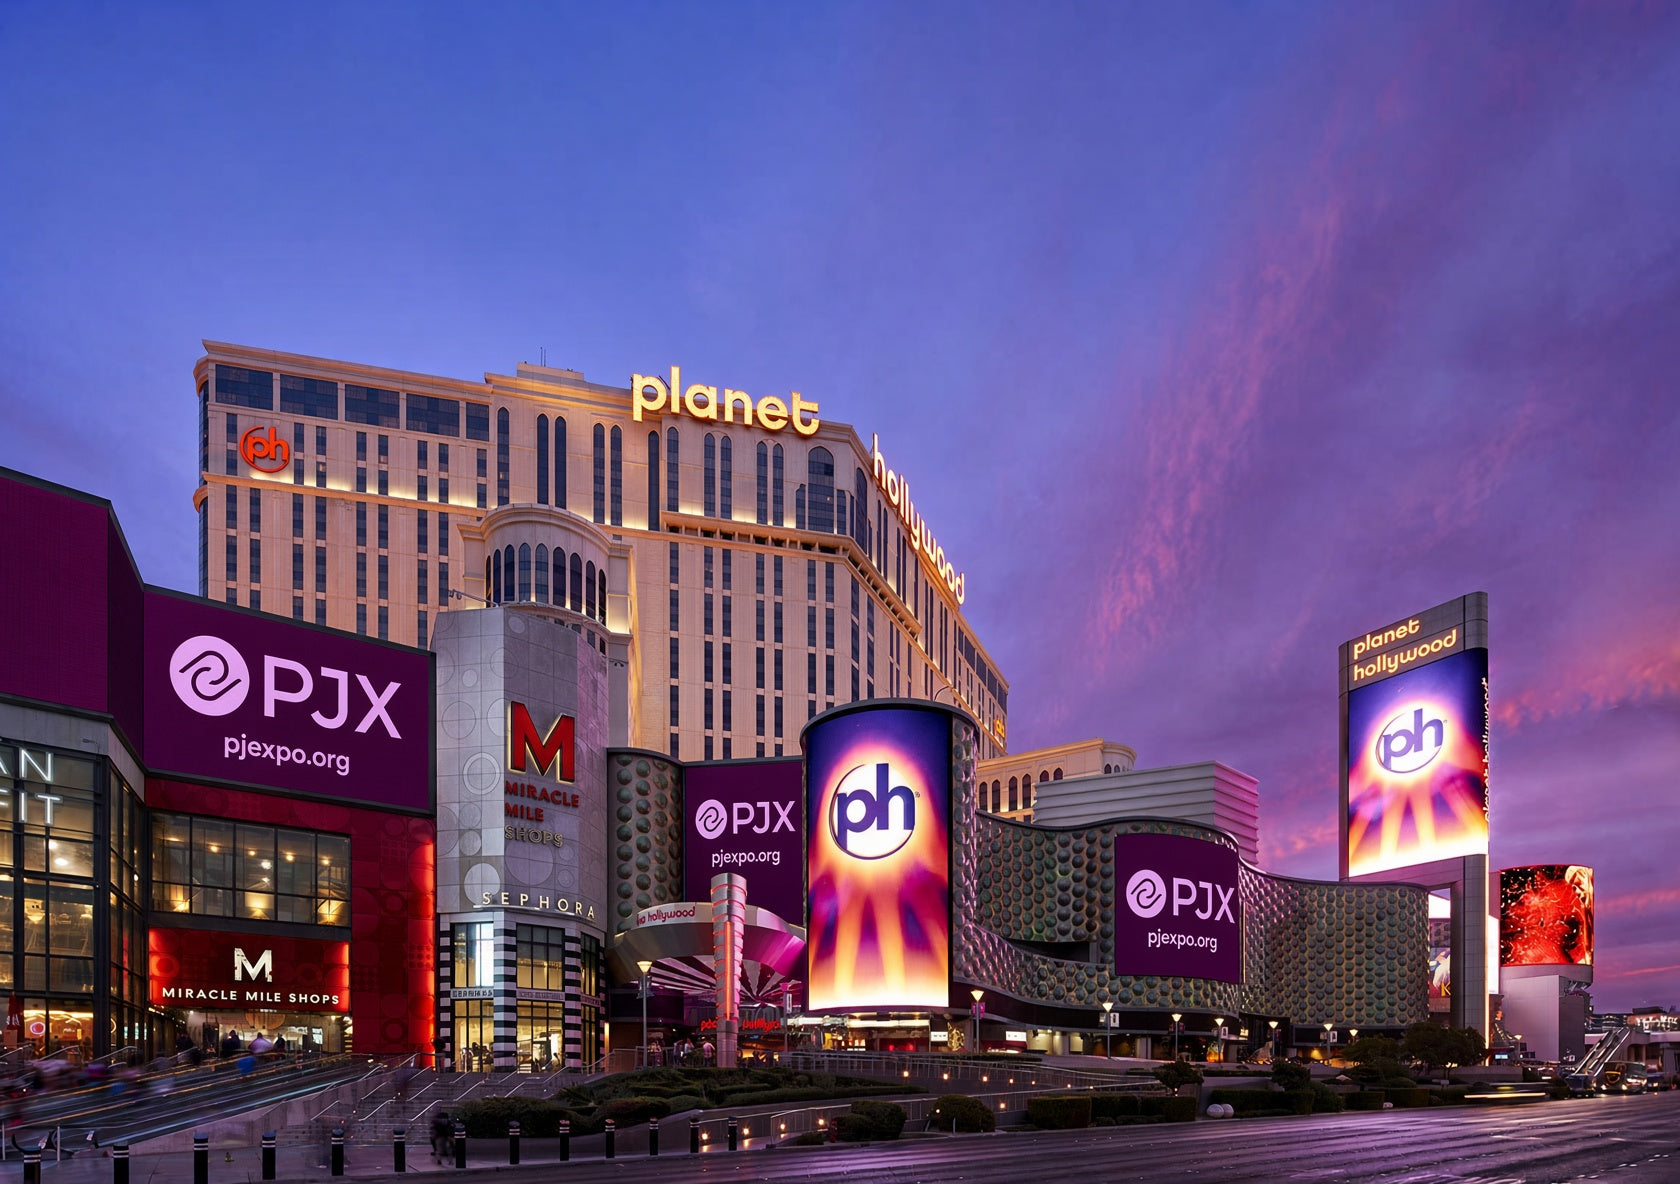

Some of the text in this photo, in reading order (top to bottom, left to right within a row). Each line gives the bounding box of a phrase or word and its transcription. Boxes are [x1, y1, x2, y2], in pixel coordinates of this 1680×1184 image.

[632, 366, 820, 436] planet
[872, 433, 965, 605] hollywood
[1353, 619, 1421, 660] planet
[1353, 629, 1458, 681] hollywood
[263, 654, 402, 740] PJX
[223, 734, 351, 776] pjexpo.org
[507, 700, 575, 785] M
[504, 780, 580, 808] MIRACLE
[504, 802, 545, 822] MILE
[732, 800, 796, 835] PJX
[504, 824, 563, 848] SHOPS
[711, 849, 781, 867] pjexpo.org
[482, 891, 595, 919] SEPHORA
[1172, 876, 1236, 924] PJX
[1147, 928, 1218, 953] pjexpo.org
[233, 947, 273, 983] M
[161, 986, 340, 1005] MIRACLE MILE SHOPS
